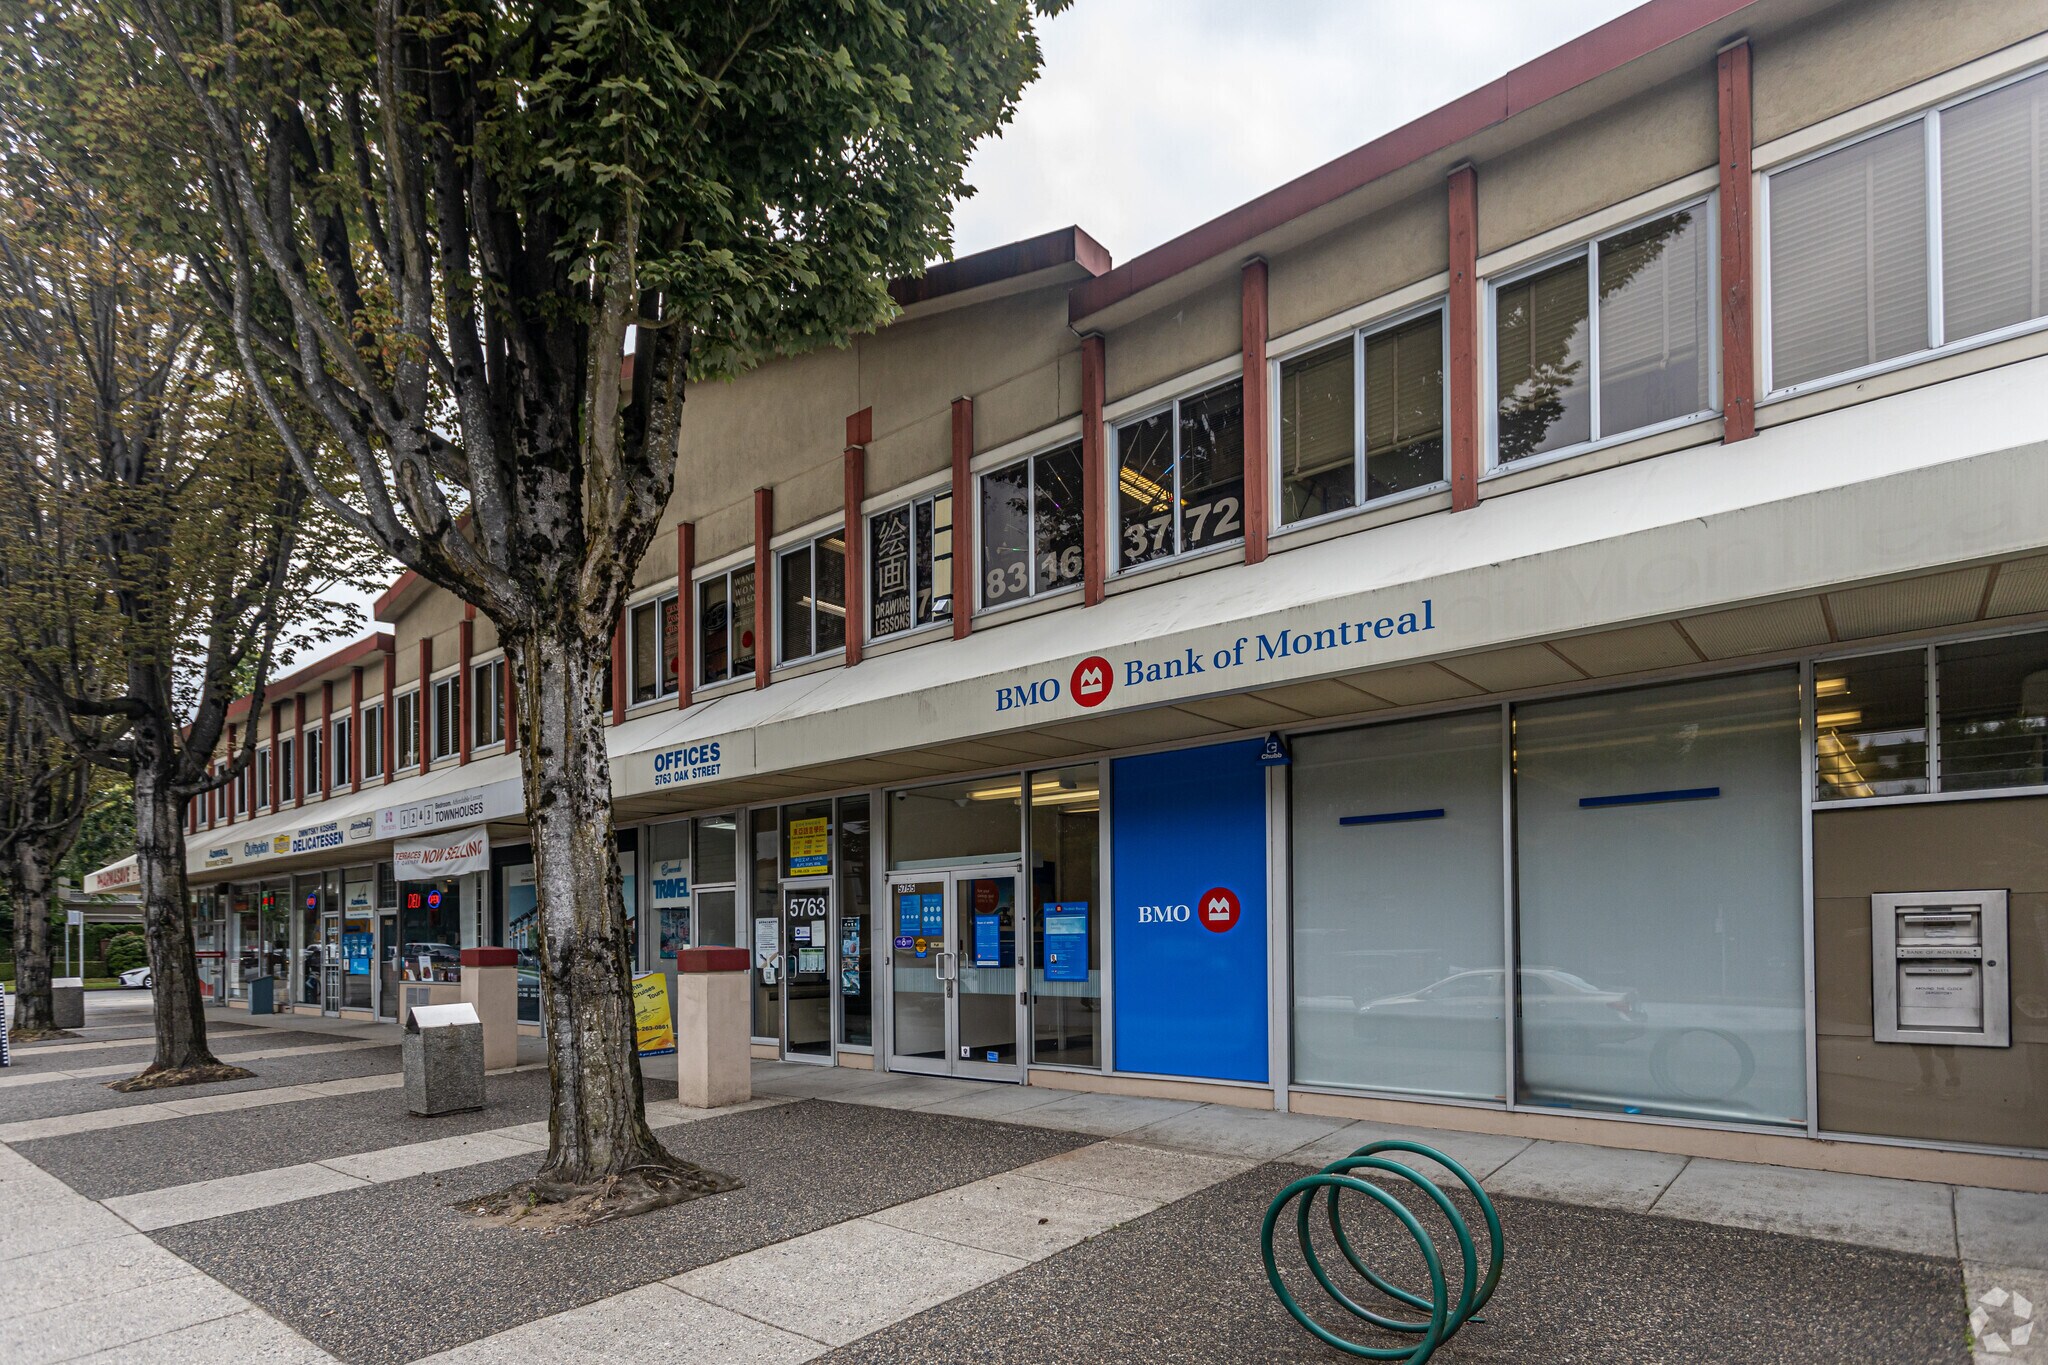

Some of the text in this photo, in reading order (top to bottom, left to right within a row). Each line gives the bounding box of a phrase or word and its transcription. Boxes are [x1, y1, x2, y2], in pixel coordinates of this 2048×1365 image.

[1123, 497, 1240, 558] 37 72
[878, 517, 908, 597] 绘画
[986, 545, 1083, 599] 83 16
[876, 596, 910, 618] DRAWING
[918, 588, 931, 618] 7
[876, 613, 910, 636] LESSONS
[996, 600, 1435, 711] BMO Bank of Montreal
[654, 742, 720, 772] OFFICES
[655, 764, 721, 786] 5763 OAK STREET
[435, 802, 484, 822] TOWNHOUSES
[320, 822, 338, 832] KOSHER
[293, 831, 344, 852] DELICATESSEN
[395, 840, 482, 864] TERRACES NOW SELLING
[653, 878, 690, 900] TRAVEL
[898, 884, 916, 893] 5755
[790, 898, 826, 917] 5763
[1138, 904, 1190, 923] BMO
[633, 986, 656, 998] Cruises
[648, 990, 664, 1000] Tours
